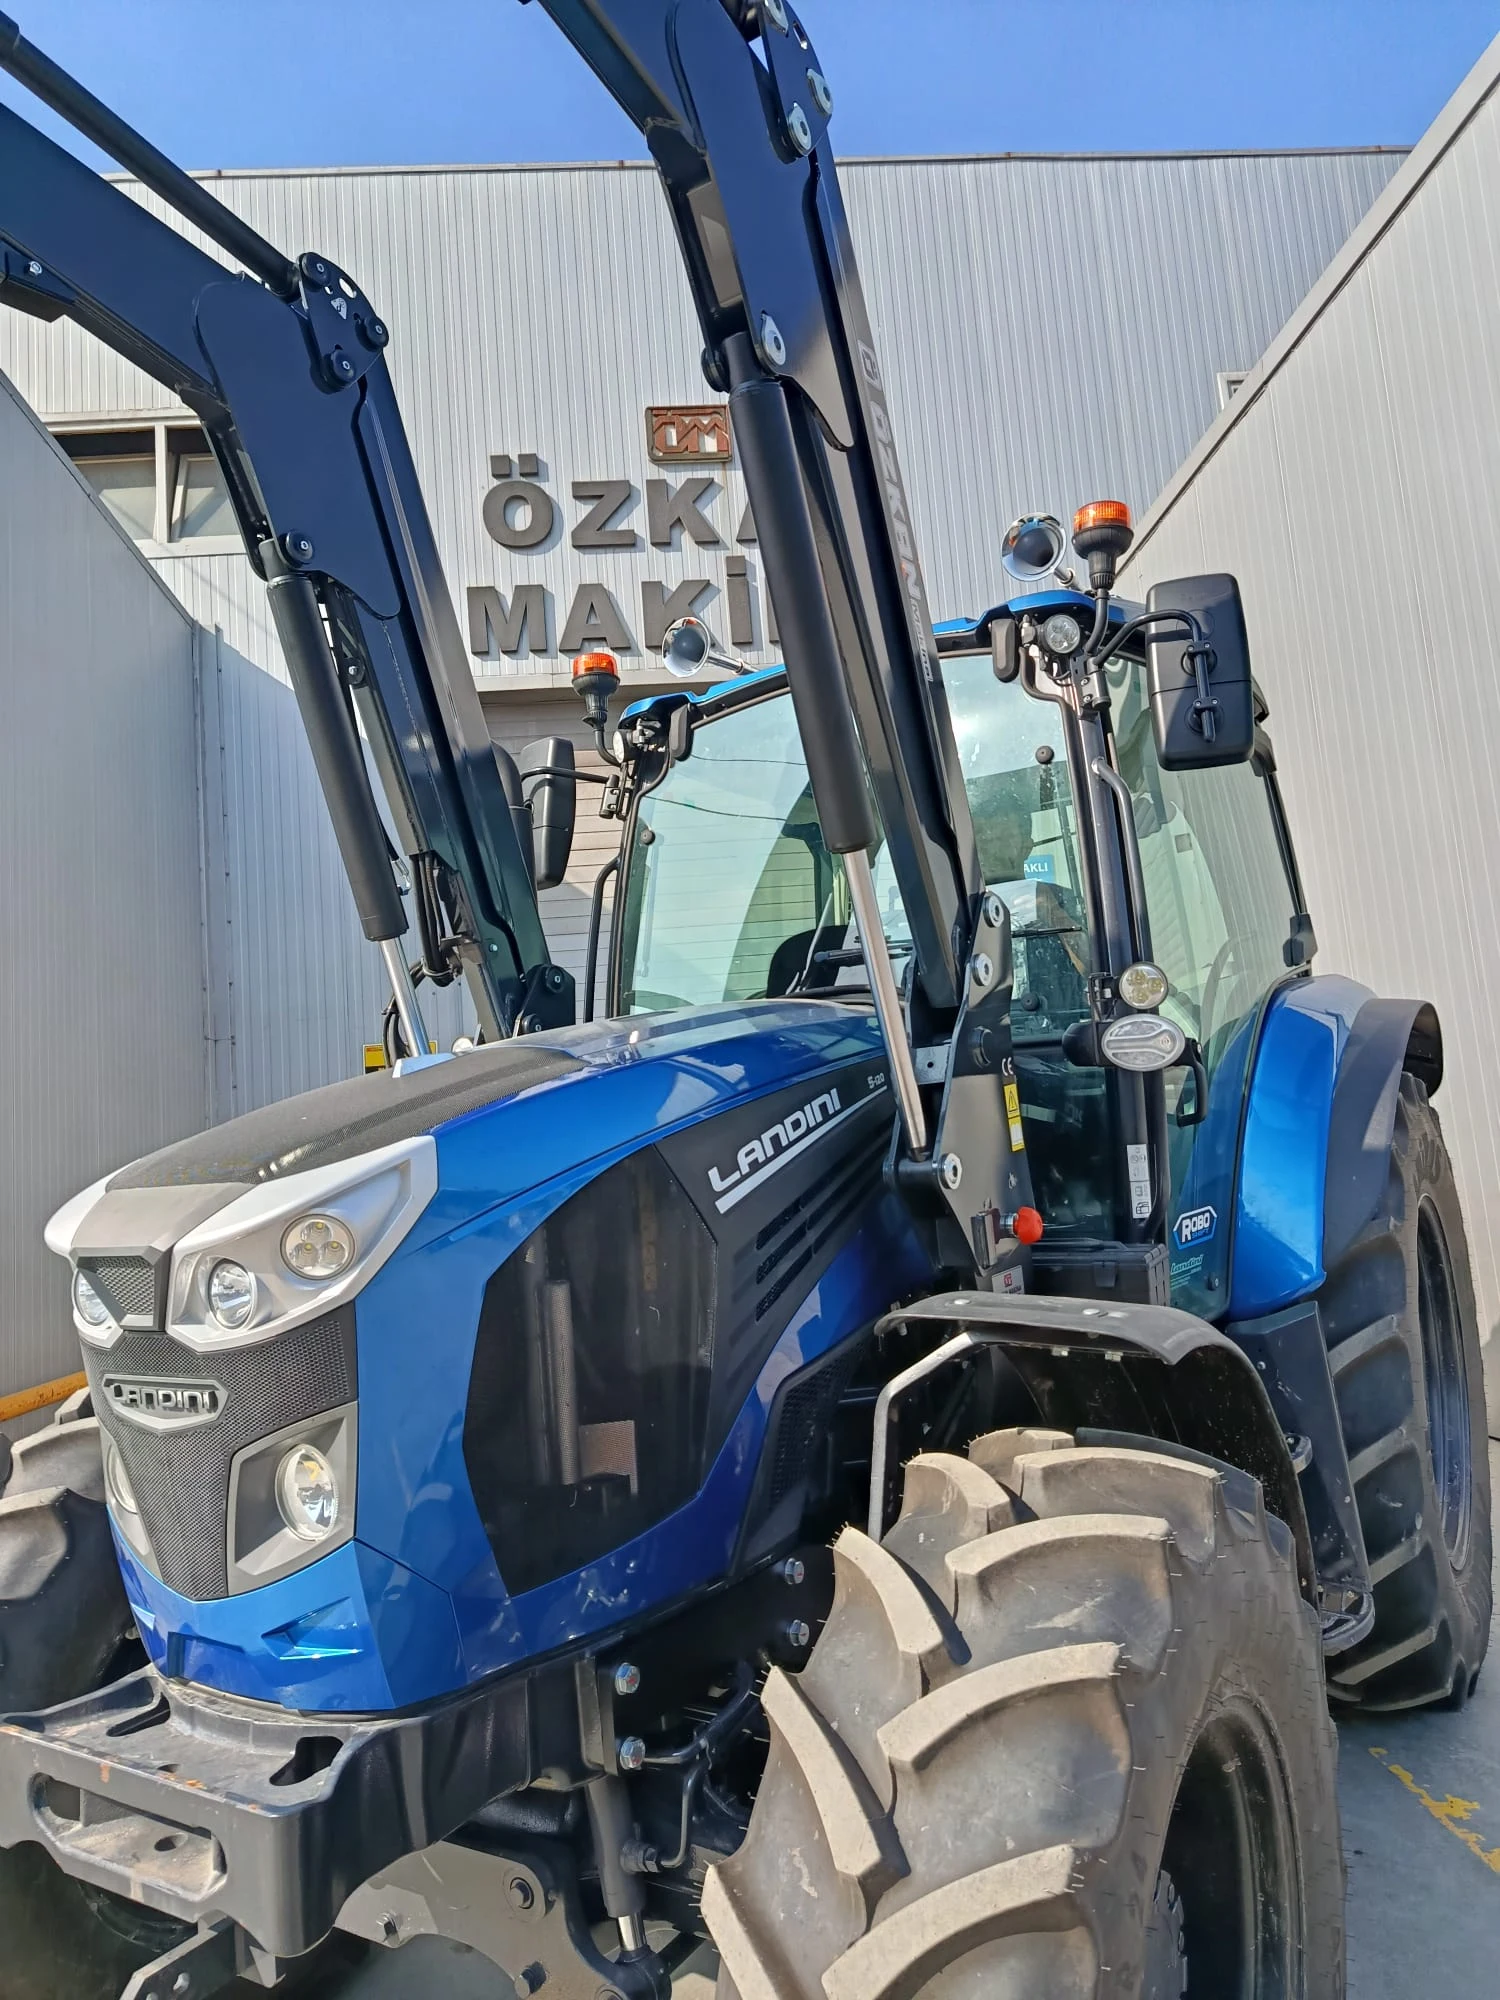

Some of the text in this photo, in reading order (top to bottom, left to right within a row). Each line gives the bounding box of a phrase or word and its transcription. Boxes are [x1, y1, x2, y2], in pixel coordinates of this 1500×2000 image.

[467, 555, 782, 655] MAKİ
[707, 1087, 842, 1193] LANDINI
[1181, 1212, 1210, 1243] ROBO
[109, 1382, 211, 1410] LANDINI
